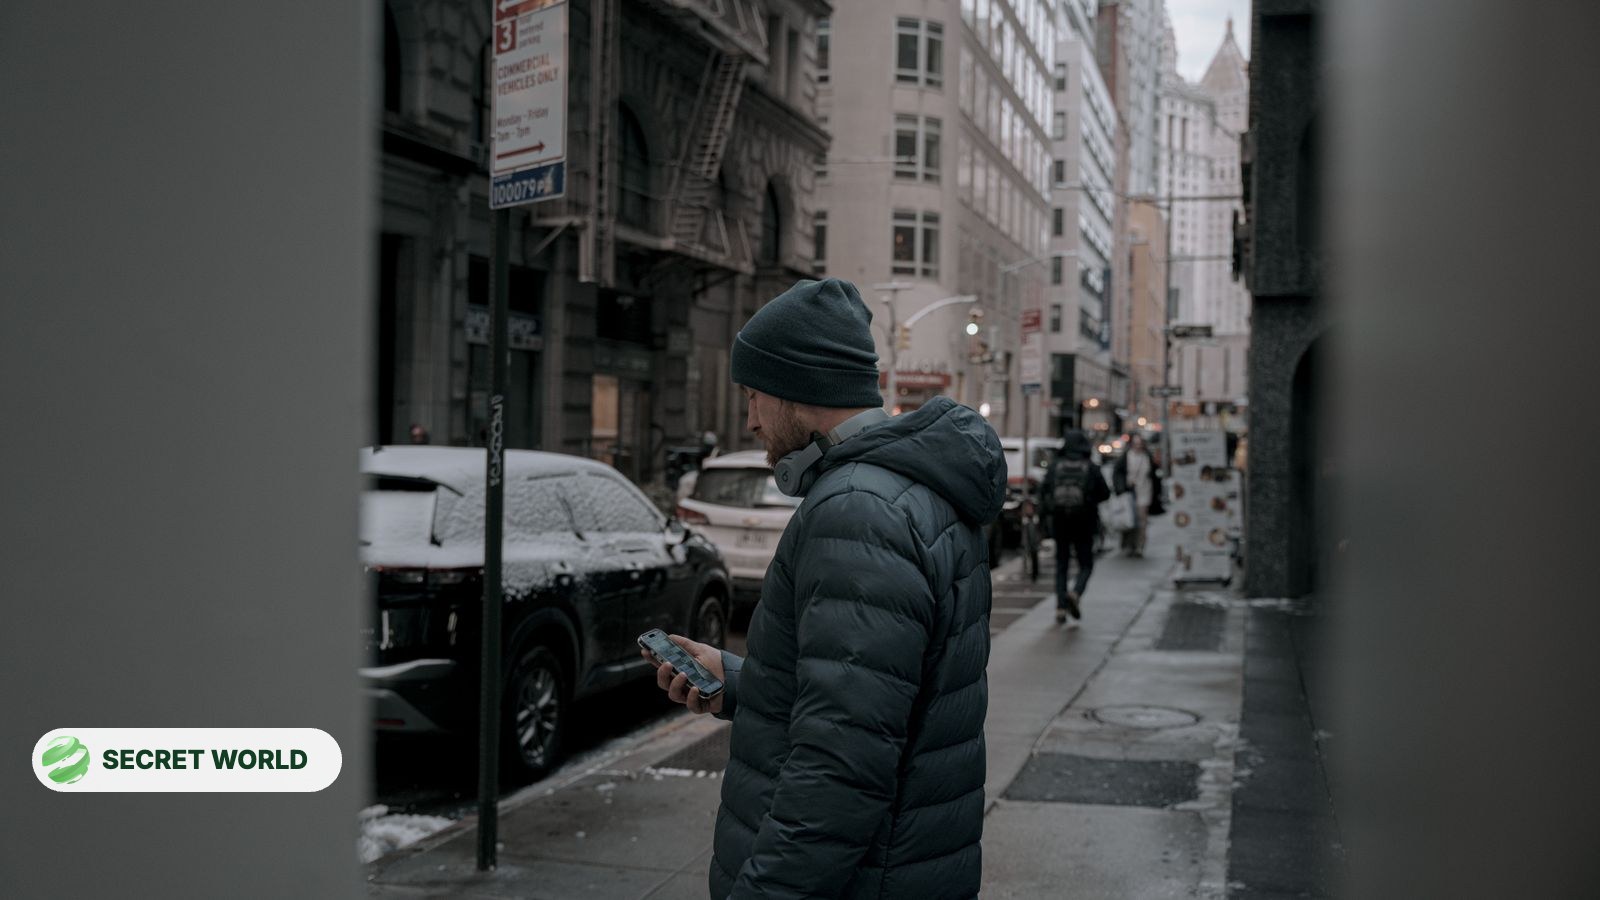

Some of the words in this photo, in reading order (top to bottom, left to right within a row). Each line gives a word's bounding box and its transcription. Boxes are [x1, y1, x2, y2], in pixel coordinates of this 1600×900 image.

[499, 22, 512, 50] 3
[498, 53, 550, 80] COMMERCIAL
[498, 75, 535, 96] VEHICLES
[538, 68, 558, 85] ONLY
[497, 115, 522, 128] Monday
[528, 108, 549, 119] Friday
